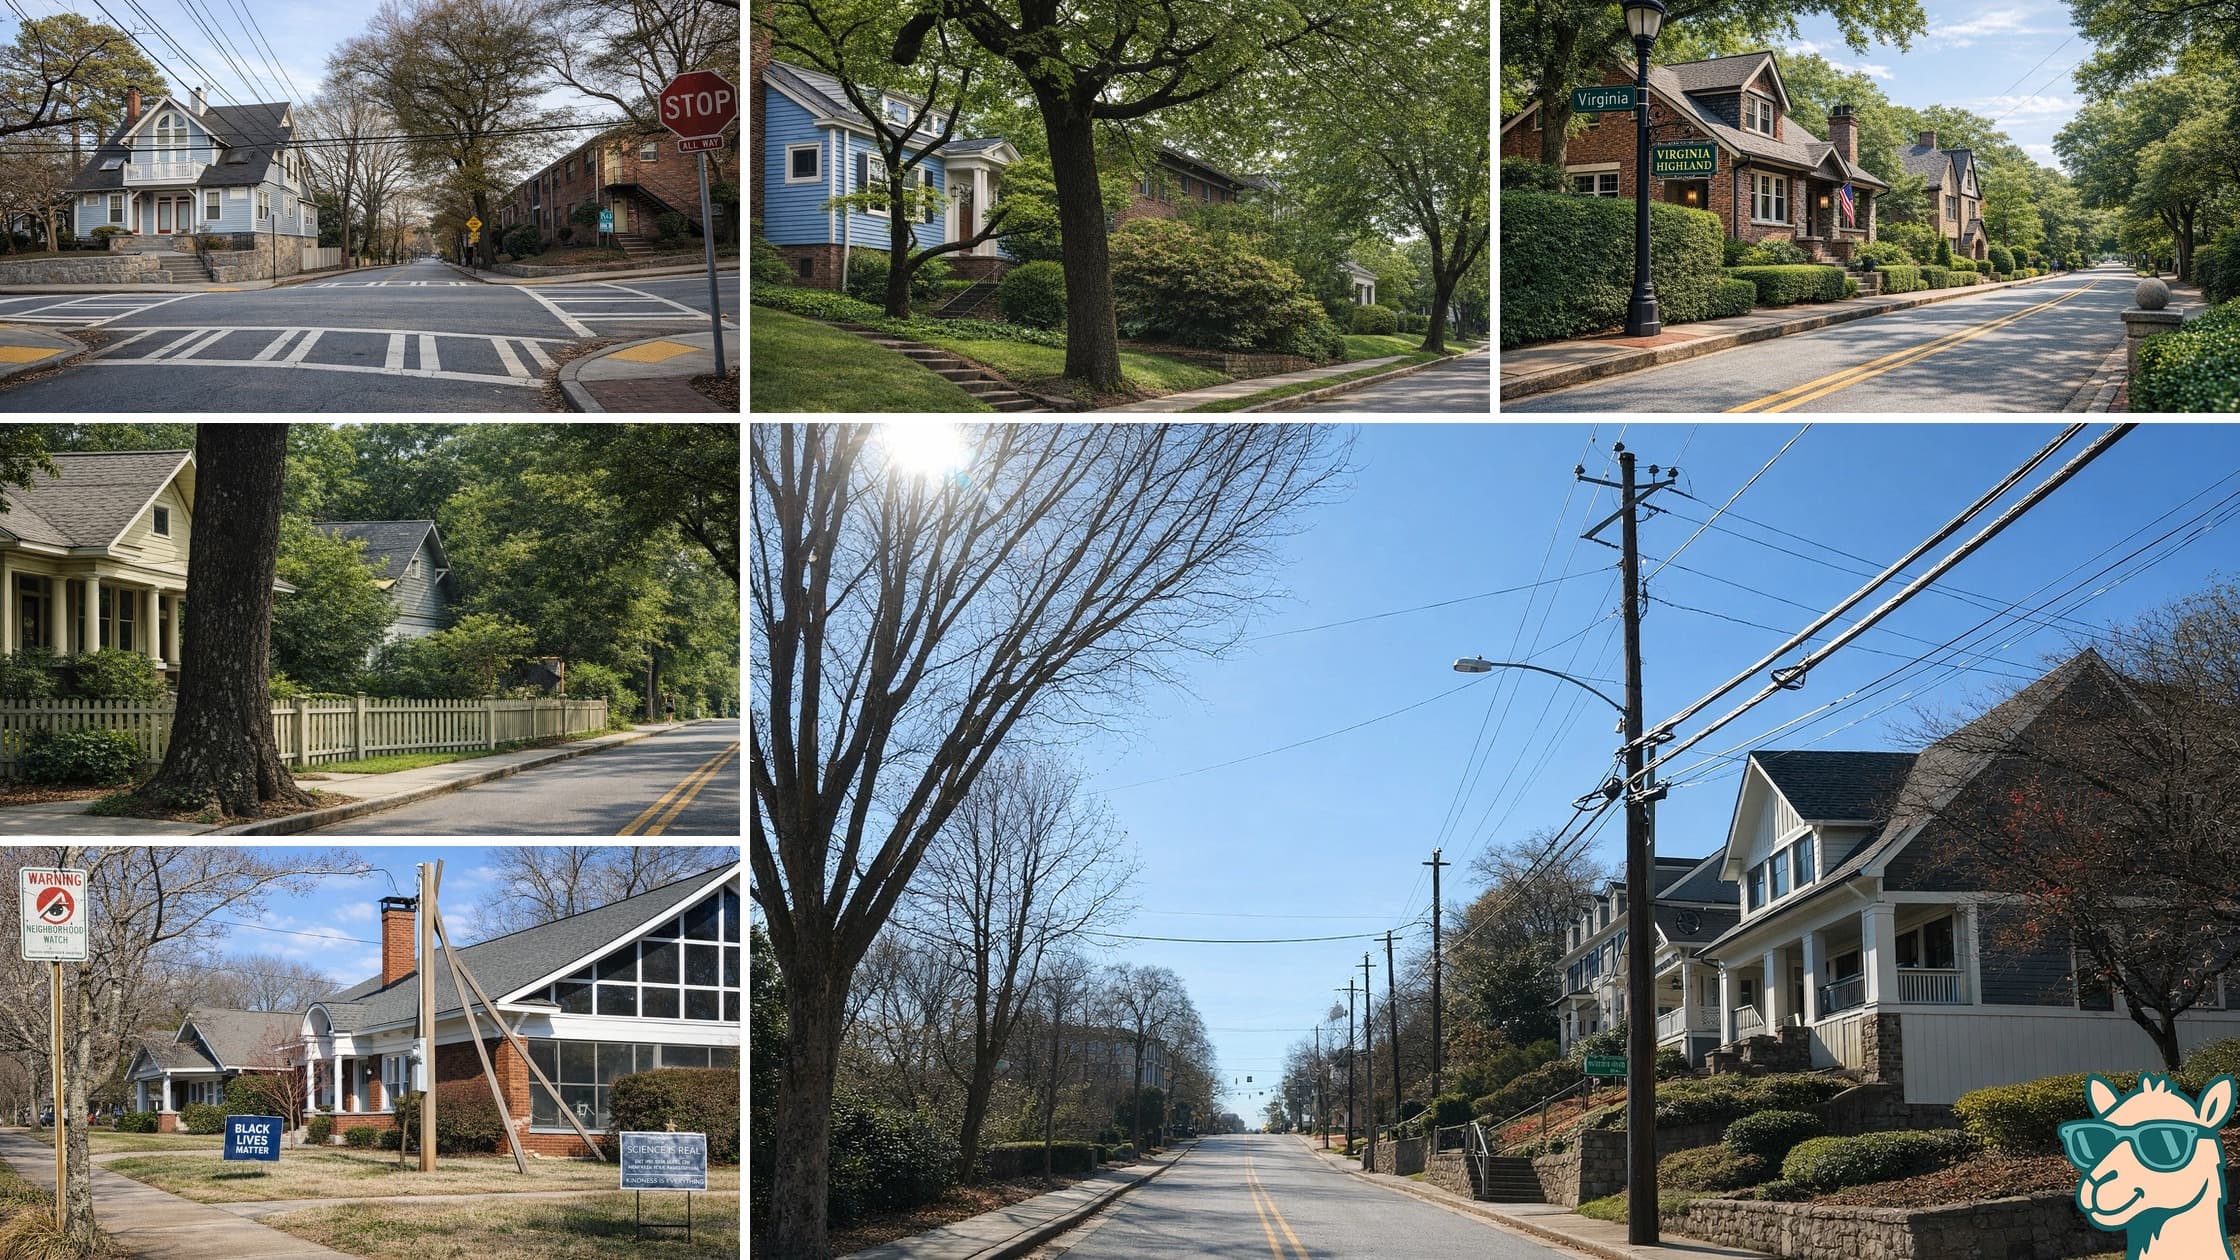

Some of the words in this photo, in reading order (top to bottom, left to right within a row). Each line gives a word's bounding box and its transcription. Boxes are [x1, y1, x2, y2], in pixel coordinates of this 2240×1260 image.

[665, 89, 731, 120] STOP
[1578, 91, 1628, 108] Virginia
[682, 142, 699, 150] ALL
[702, 138, 719, 148] WAY
[1657, 148, 1711, 160] VIRGINIA
[1656, 160, 1712, 171] HIGHLAND
[28, 872, 82, 887] WARNING
[26, 924, 84, 934] NEIGHBORHOOD
[43, 935, 68, 944] WATCH
[235, 1123, 270, 1134] BLACK
[236, 1135, 268, 1145] LIVES
[235, 1145, 269, 1154] MATTER
[627, 1145, 666, 1154] SCIENCE
[668, 1146, 675, 1154] IS
[678, 1146, 701, 1155] REAL
